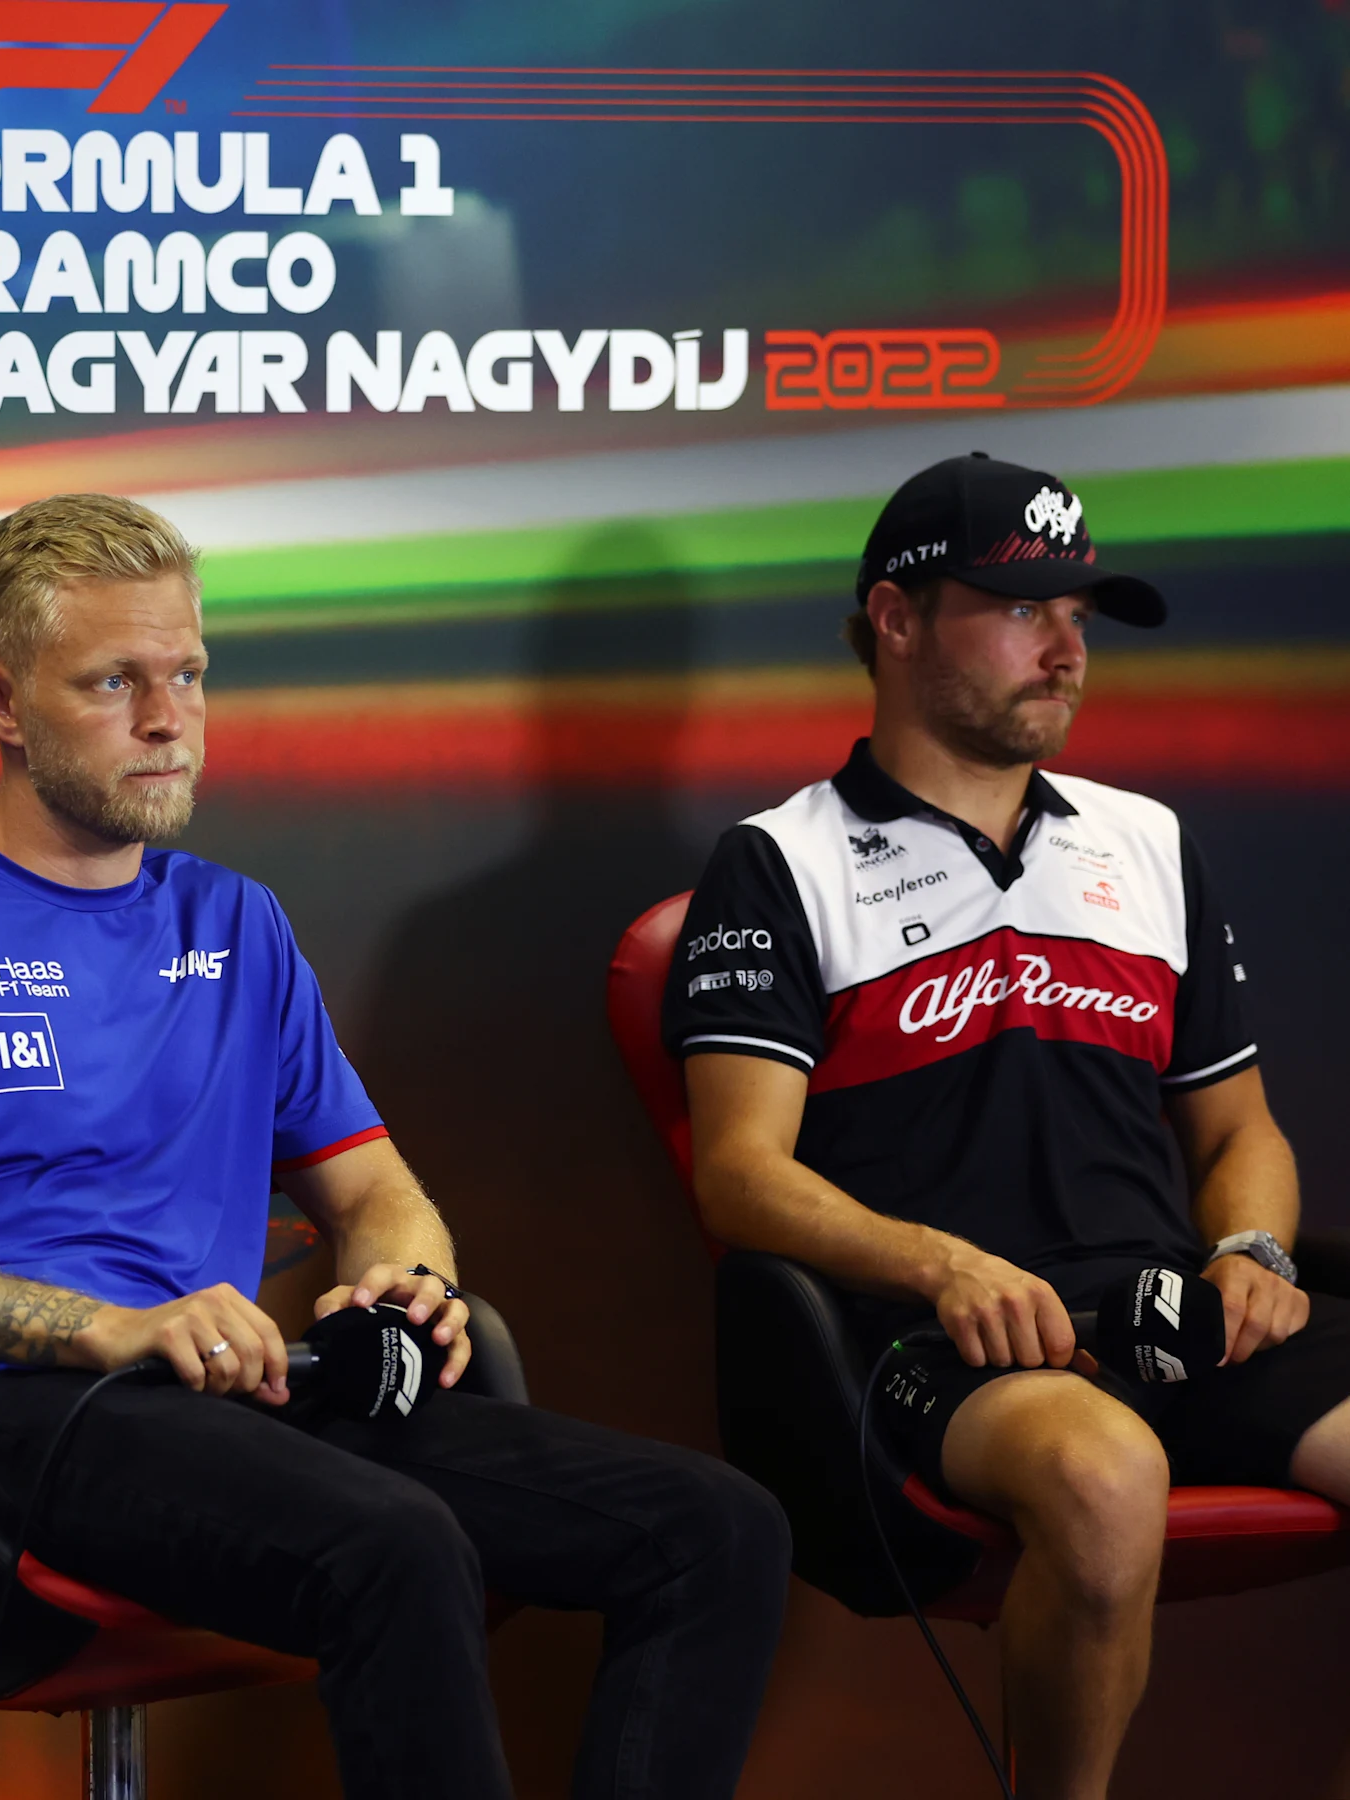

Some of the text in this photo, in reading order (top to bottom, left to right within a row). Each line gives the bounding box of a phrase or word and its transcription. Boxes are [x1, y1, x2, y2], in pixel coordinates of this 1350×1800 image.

[400, 133, 454, 216] 1
[764, 329, 1007, 411] 2022
[687, 923, 773, 961] zadara
[21, 980, 70, 997] Team
[899, 953, 1159, 1042] Alfa Romeo
[389, 1326, 398, 1345] FIA
